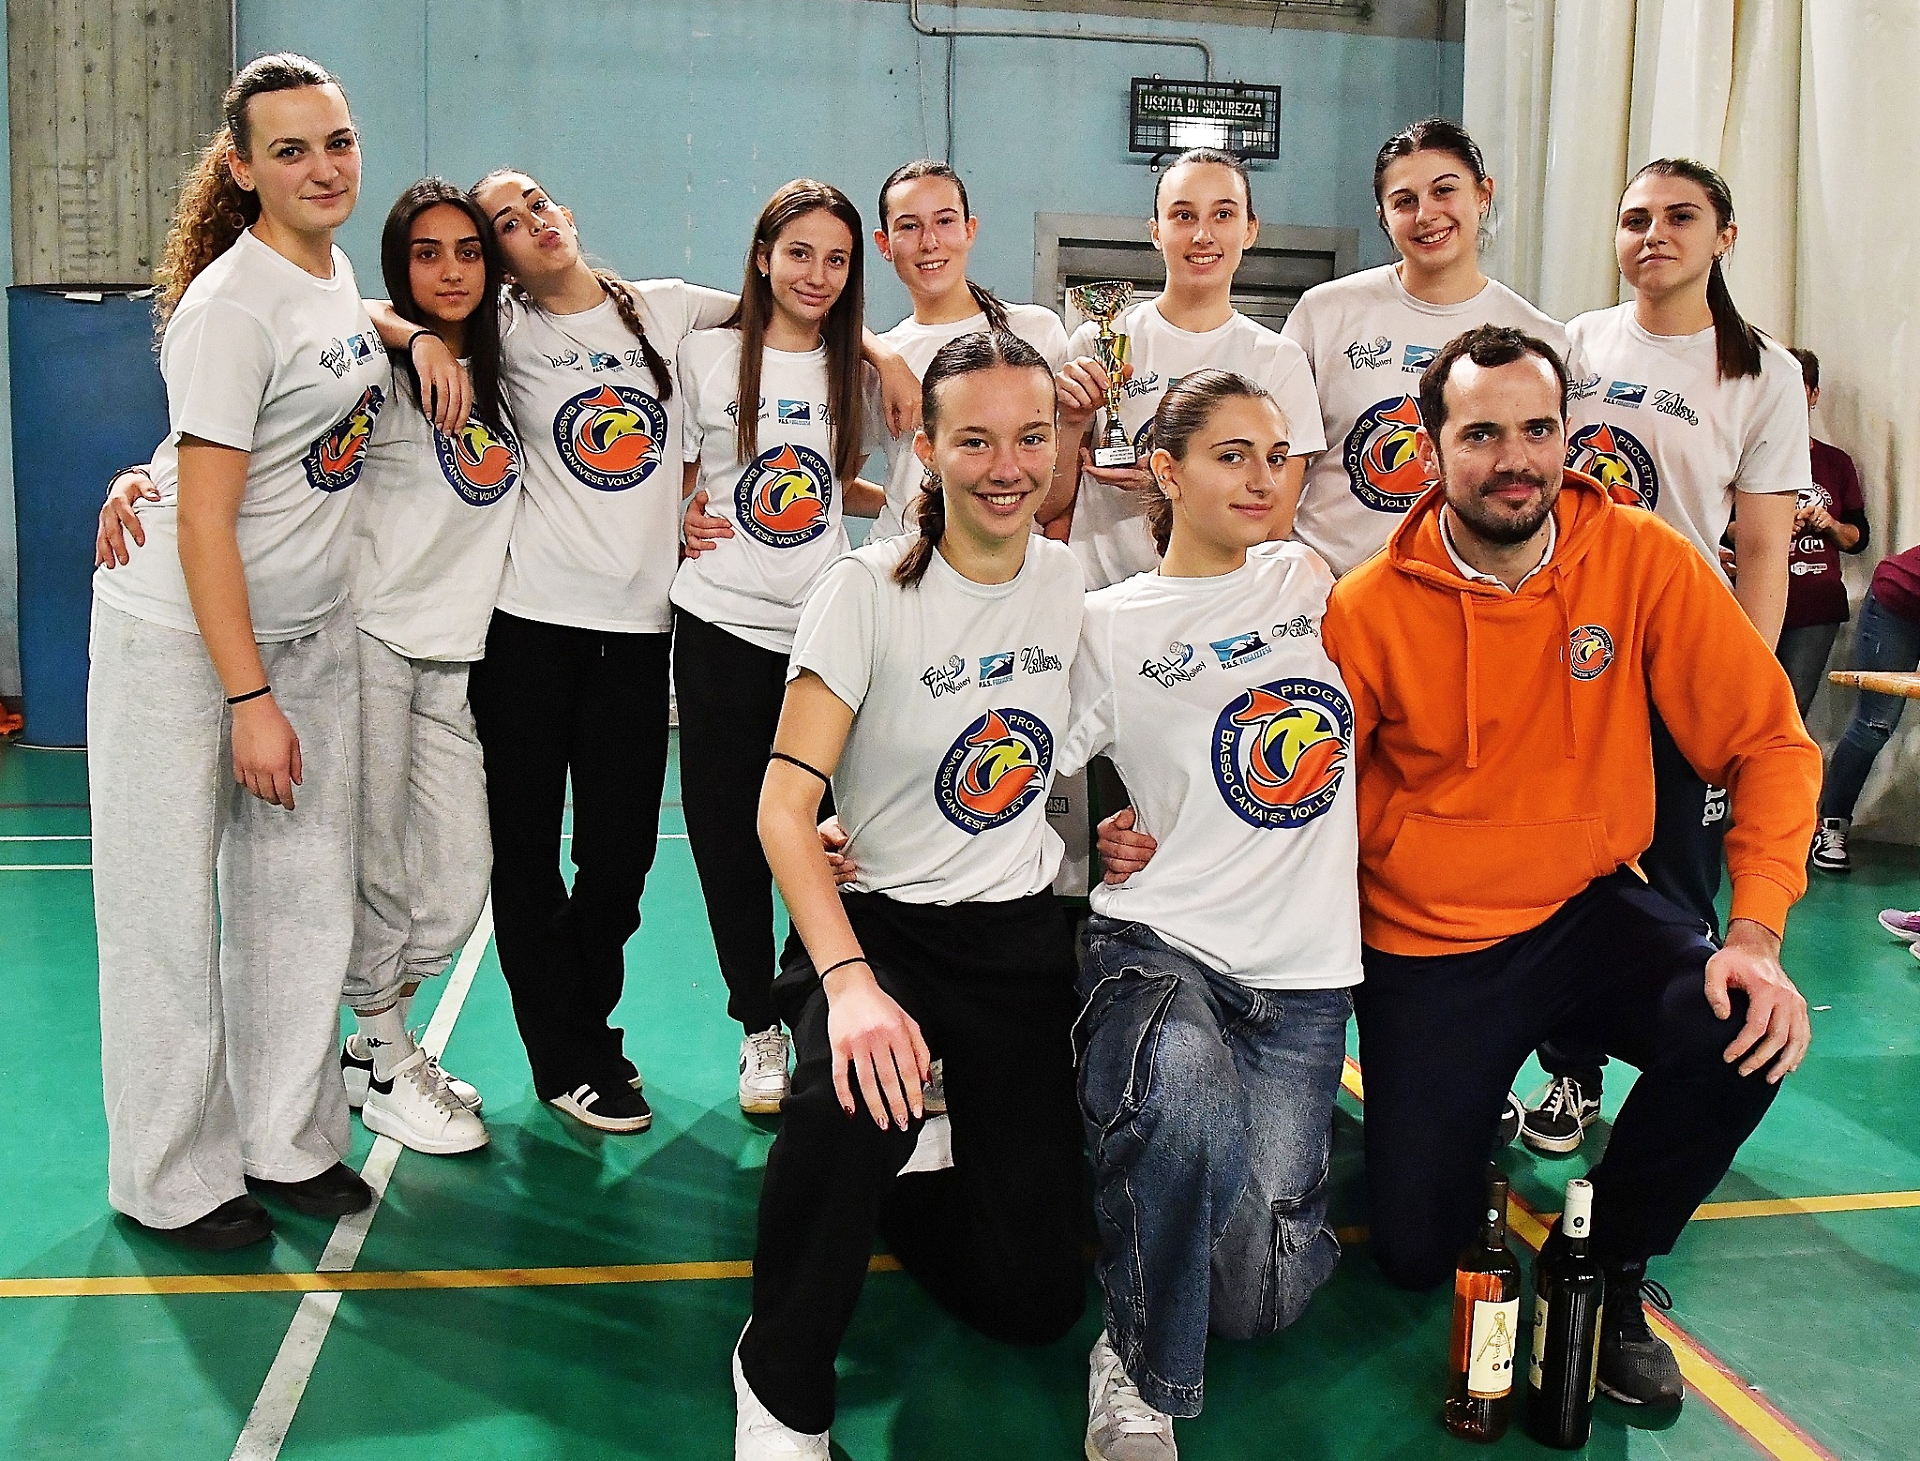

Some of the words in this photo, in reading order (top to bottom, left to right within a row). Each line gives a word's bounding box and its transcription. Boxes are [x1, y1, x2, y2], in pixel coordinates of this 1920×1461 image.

[1144, 95, 1183, 112] USCITA
[1187, 98, 1199, 113] DI
[1203, 99, 1262, 118] SICUREZZA
[558, 405, 577, 440] BASSO
[622, 390, 663, 441] PROGETTO
[562, 442, 606, 486] CANAVESE
[606, 468, 645, 487] VOLLEY
[800, 451, 830, 504] PROGETTO
[1350, 418, 1373, 451] BASSO
[1378, 497, 1418, 508] VOLLE
[1617, 434, 1654, 498] PROGETTO
[479, 481, 507, 501] VOLLEY
[741, 467, 760, 501] BASSO
[776, 529, 814, 545] VOLLEY
[1020, 645, 1061, 672] Volley
[1280, 684, 1352, 739] PROGETTO
[1008, 714, 1050, 766] PROGETTO
[941, 748, 965, 788] BASSO
[988, 797, 1026, 826] OLLEY
[1219, 729, 1235, 784] BASSO
[1290, 783, 1339, 820] VOLLEY
